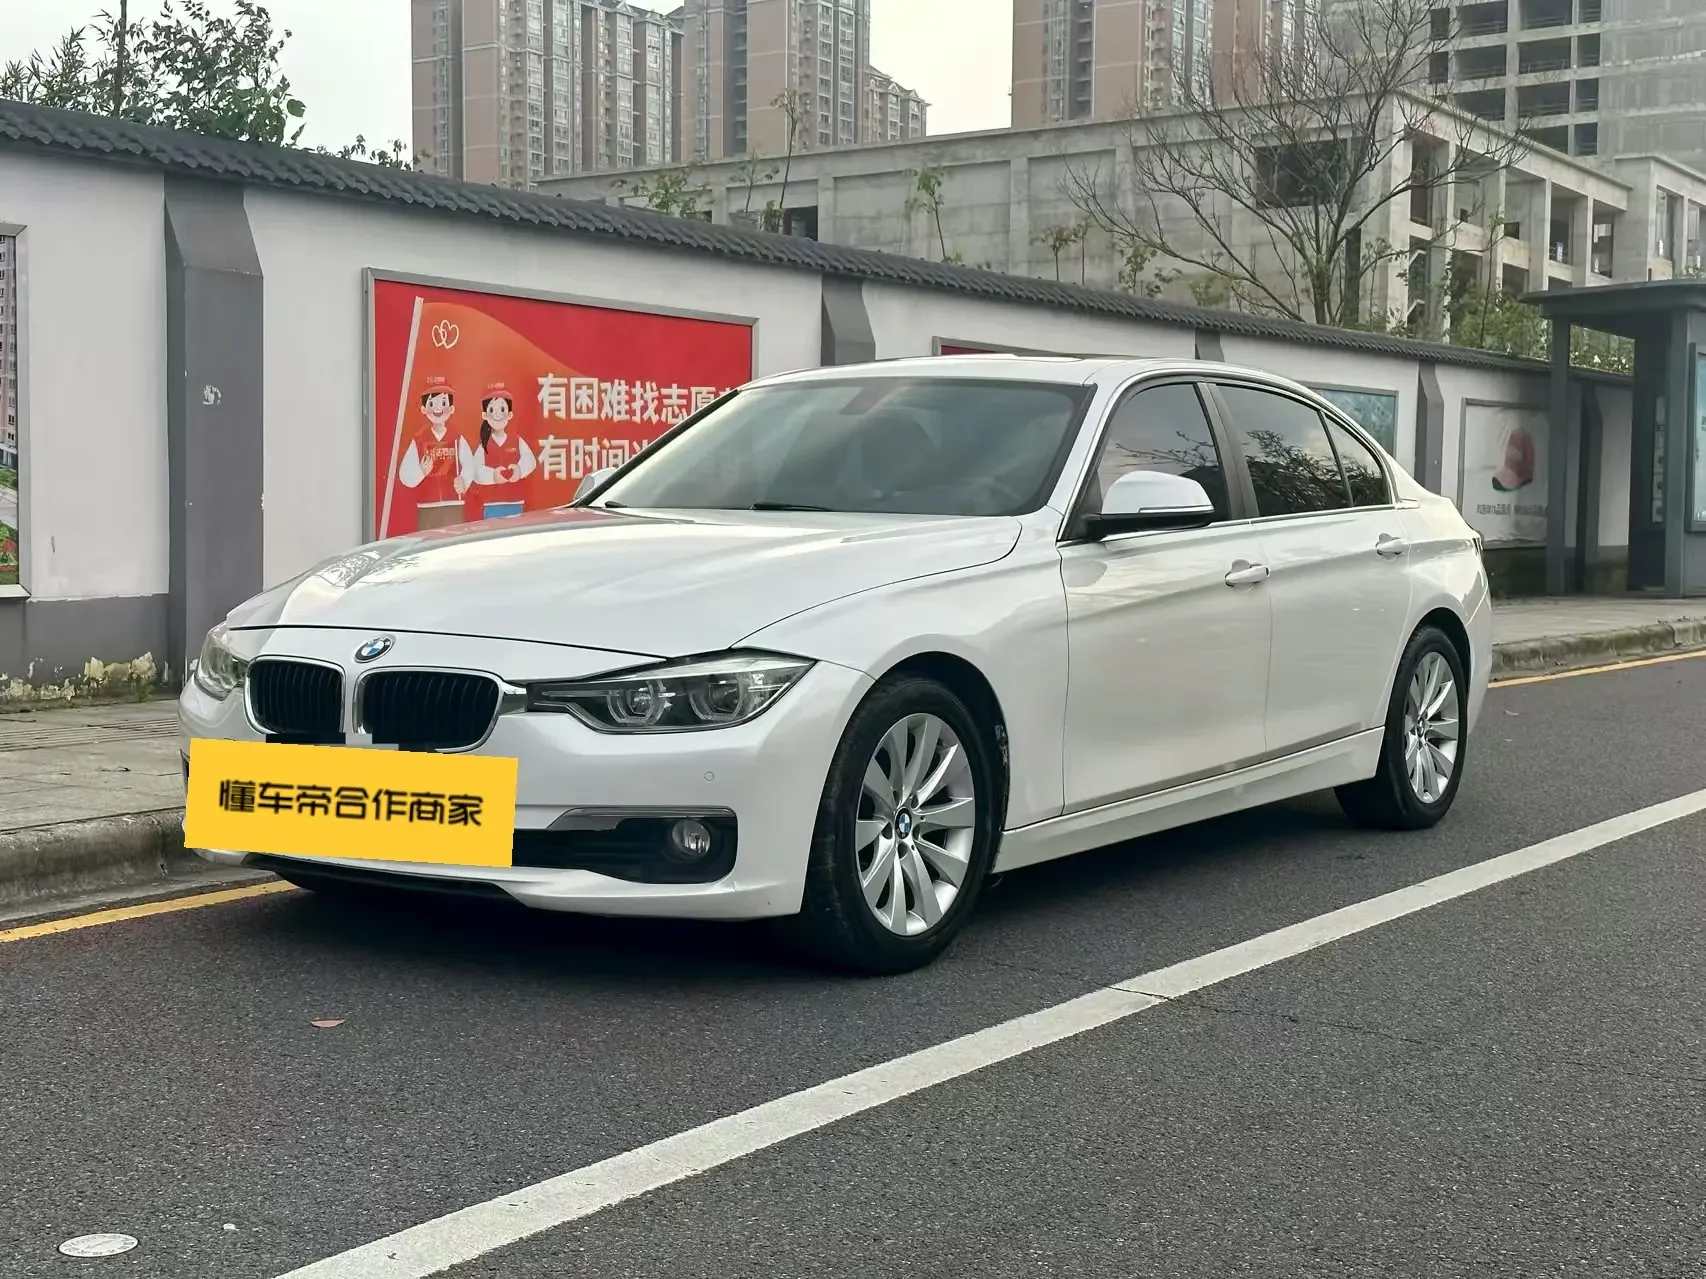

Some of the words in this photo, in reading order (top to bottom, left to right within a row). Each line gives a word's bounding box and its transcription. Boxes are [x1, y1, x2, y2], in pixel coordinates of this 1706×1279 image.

[537, 373, 730, 425] 有困难找志愿
